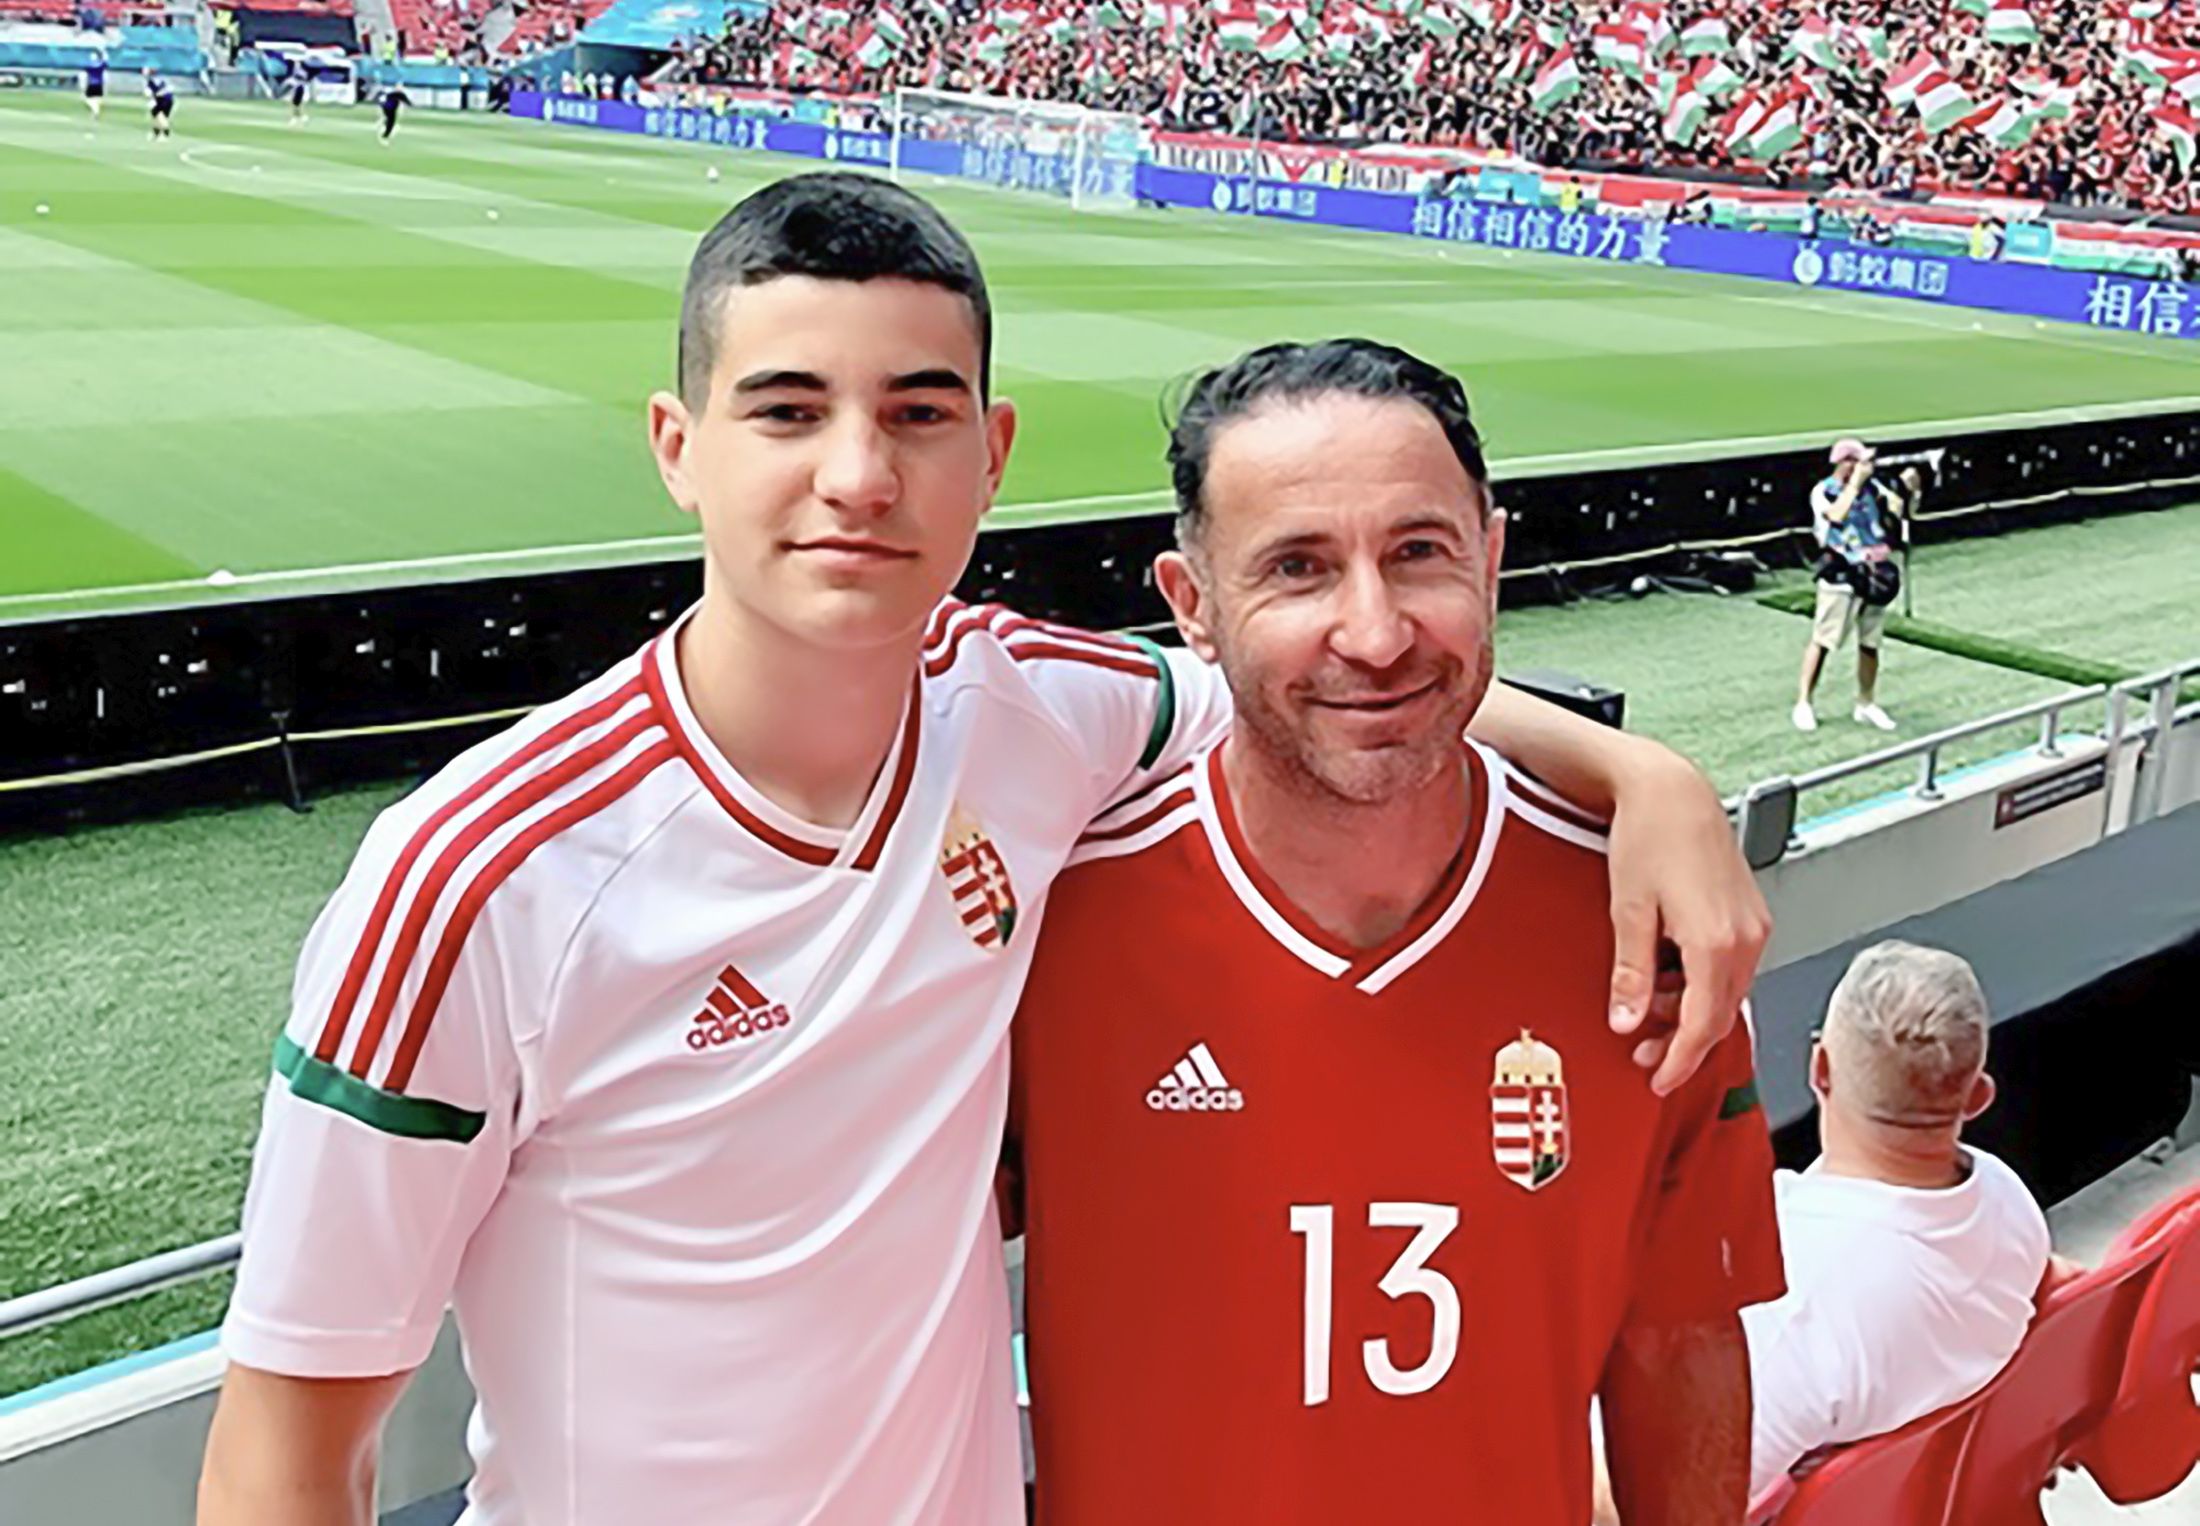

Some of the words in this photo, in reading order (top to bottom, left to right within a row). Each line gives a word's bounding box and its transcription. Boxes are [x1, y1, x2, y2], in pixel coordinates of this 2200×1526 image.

[1412, 200, 1670, 266] 相信相信的力量
[2083, 275, 2200, 335] 相信
[686, 1004, 790, 1050] adidas
[1146, 1088, 1244, 1111] adidas
[1290, 1202, 1461, 1406] 13
